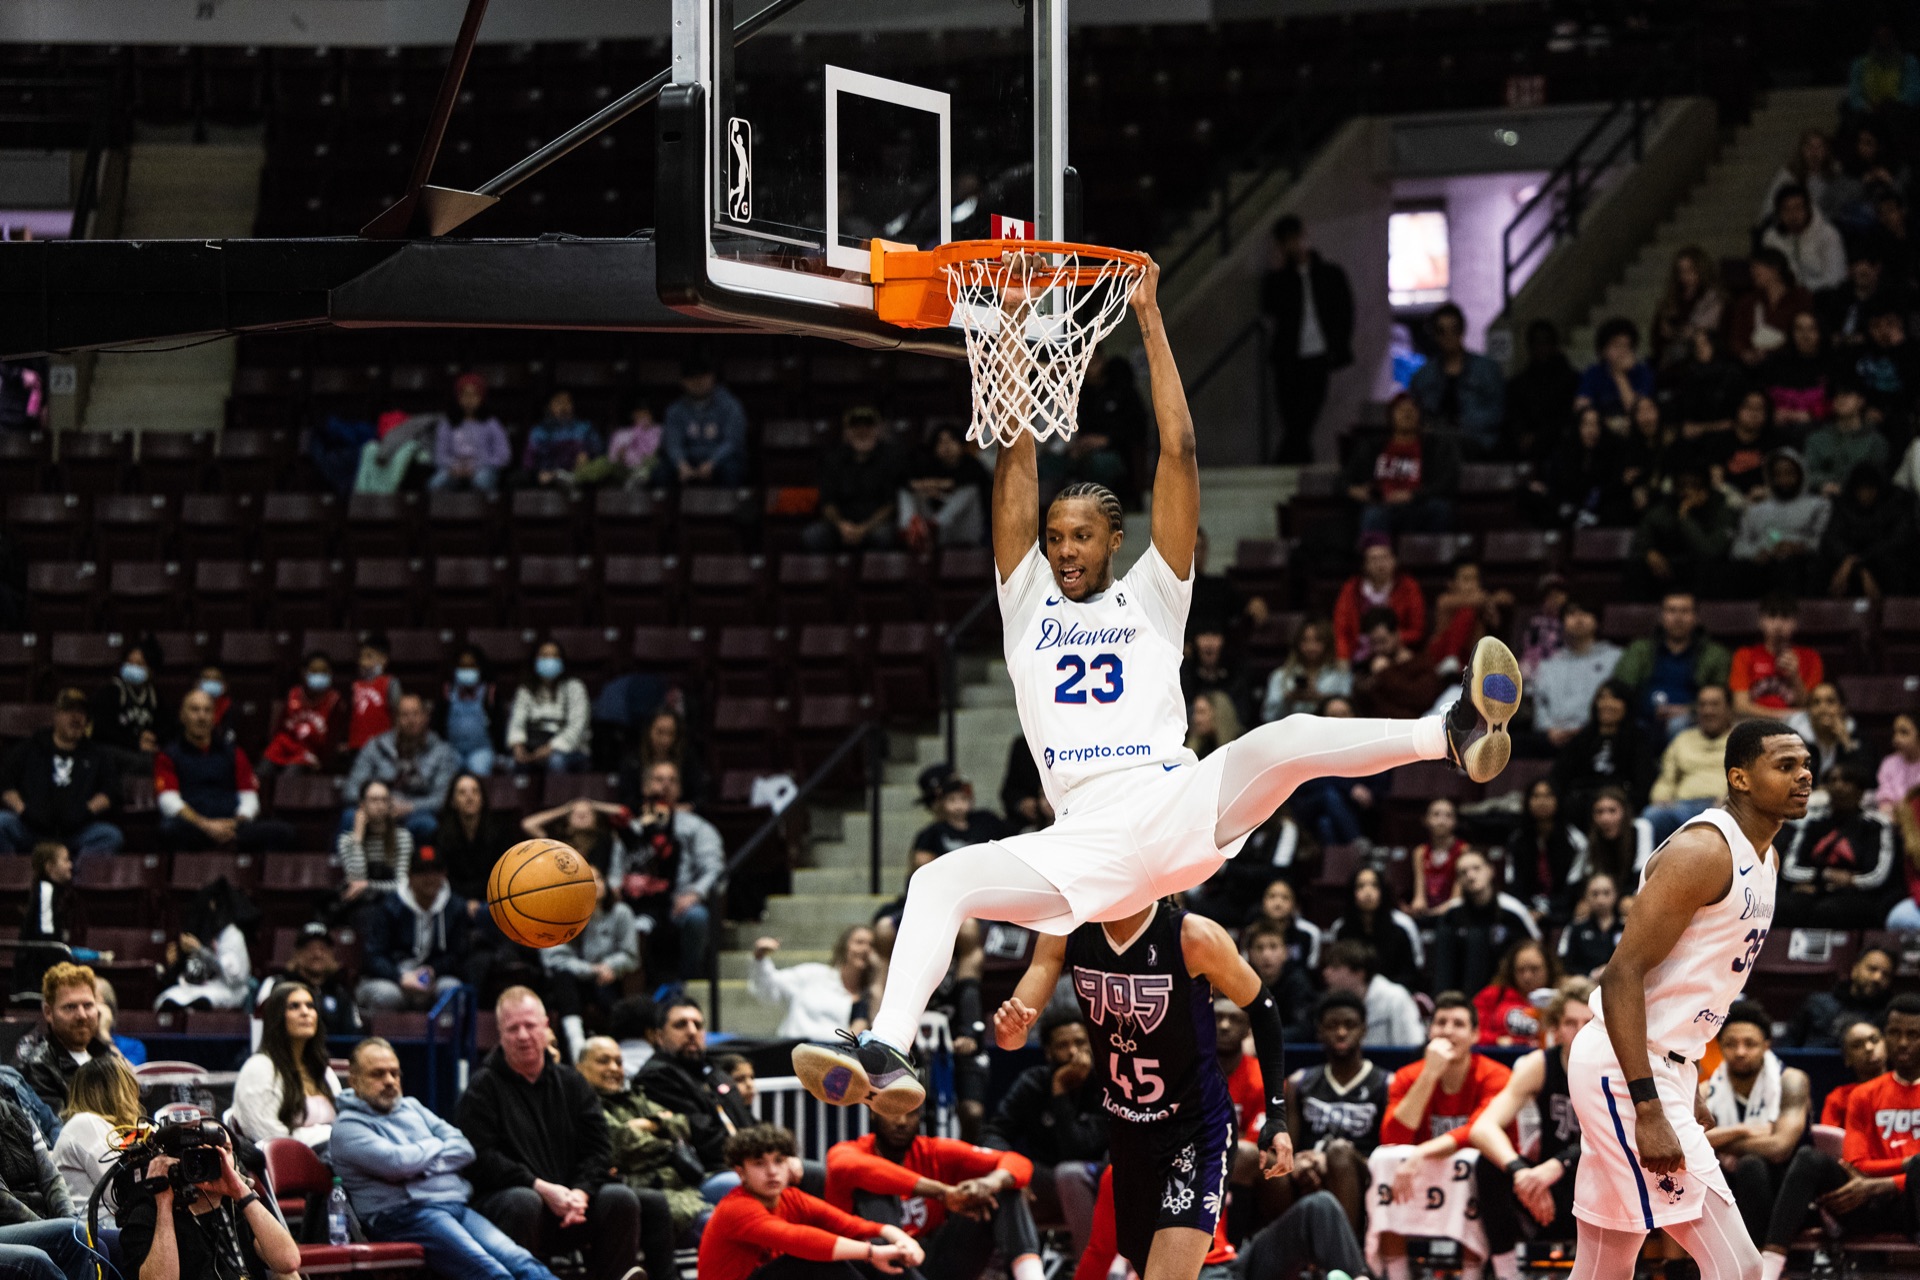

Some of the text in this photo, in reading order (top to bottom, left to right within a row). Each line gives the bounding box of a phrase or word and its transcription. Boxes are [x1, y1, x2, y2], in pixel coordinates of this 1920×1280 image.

[1035, 617, 1137, 651] Delaware
[1054, 653, 1125, 704] 23
[1058, 744, 1151, 763] crypto.com
[1073, 965, 1174, 1035] 905
[1109, 1052, 1166, 1105] 45
